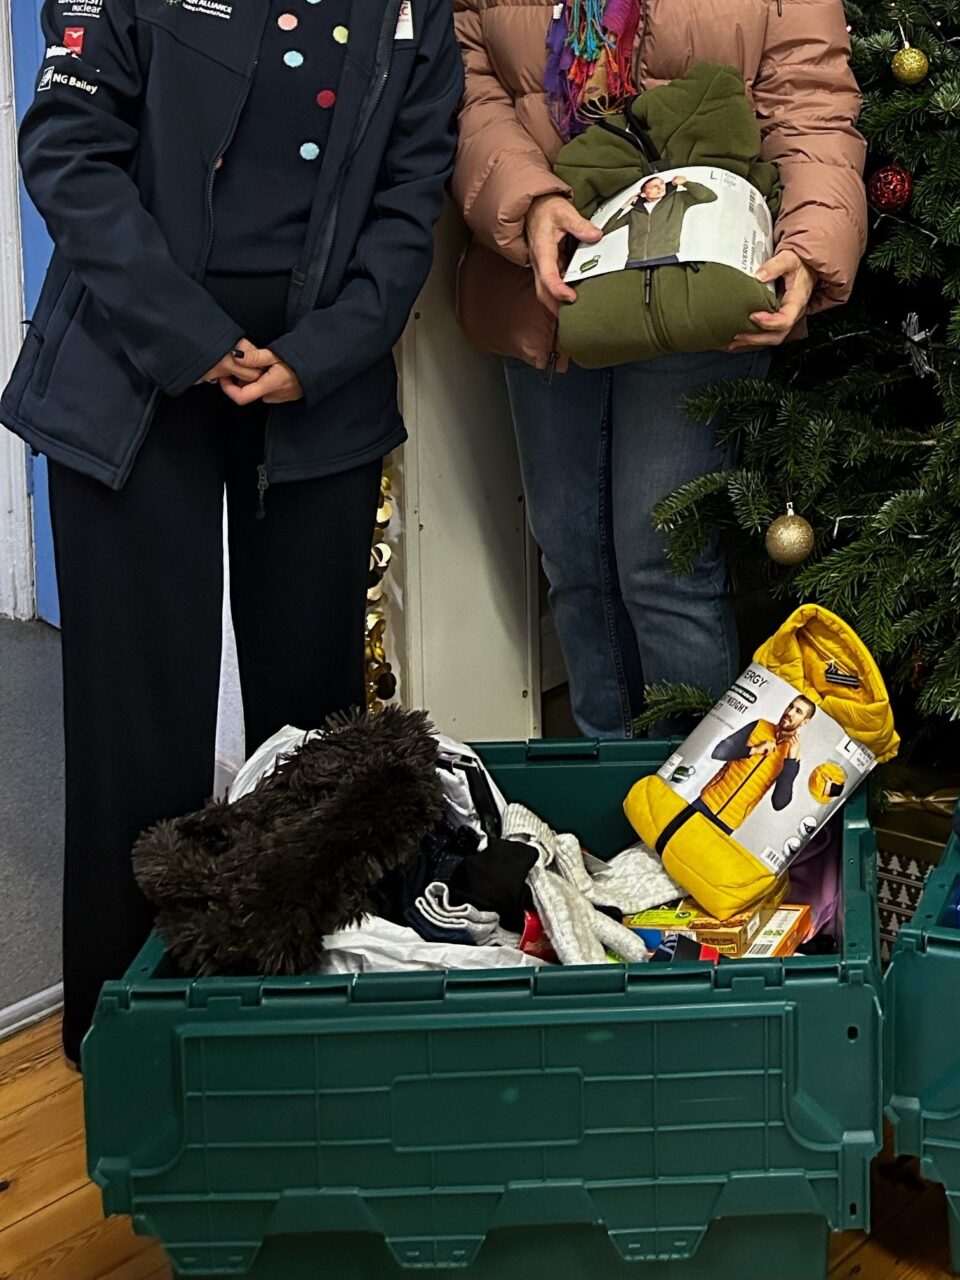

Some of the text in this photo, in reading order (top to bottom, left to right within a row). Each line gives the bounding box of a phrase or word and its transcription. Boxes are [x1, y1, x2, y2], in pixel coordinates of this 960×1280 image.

[72, 4, 102, 14] nuclear
[198, 0, 233, 14] ALLIANCE
[53, 73, 98, 95] NG Bailey
[710, 170, 718, 180] L
[844, 739, 852, 753] L
